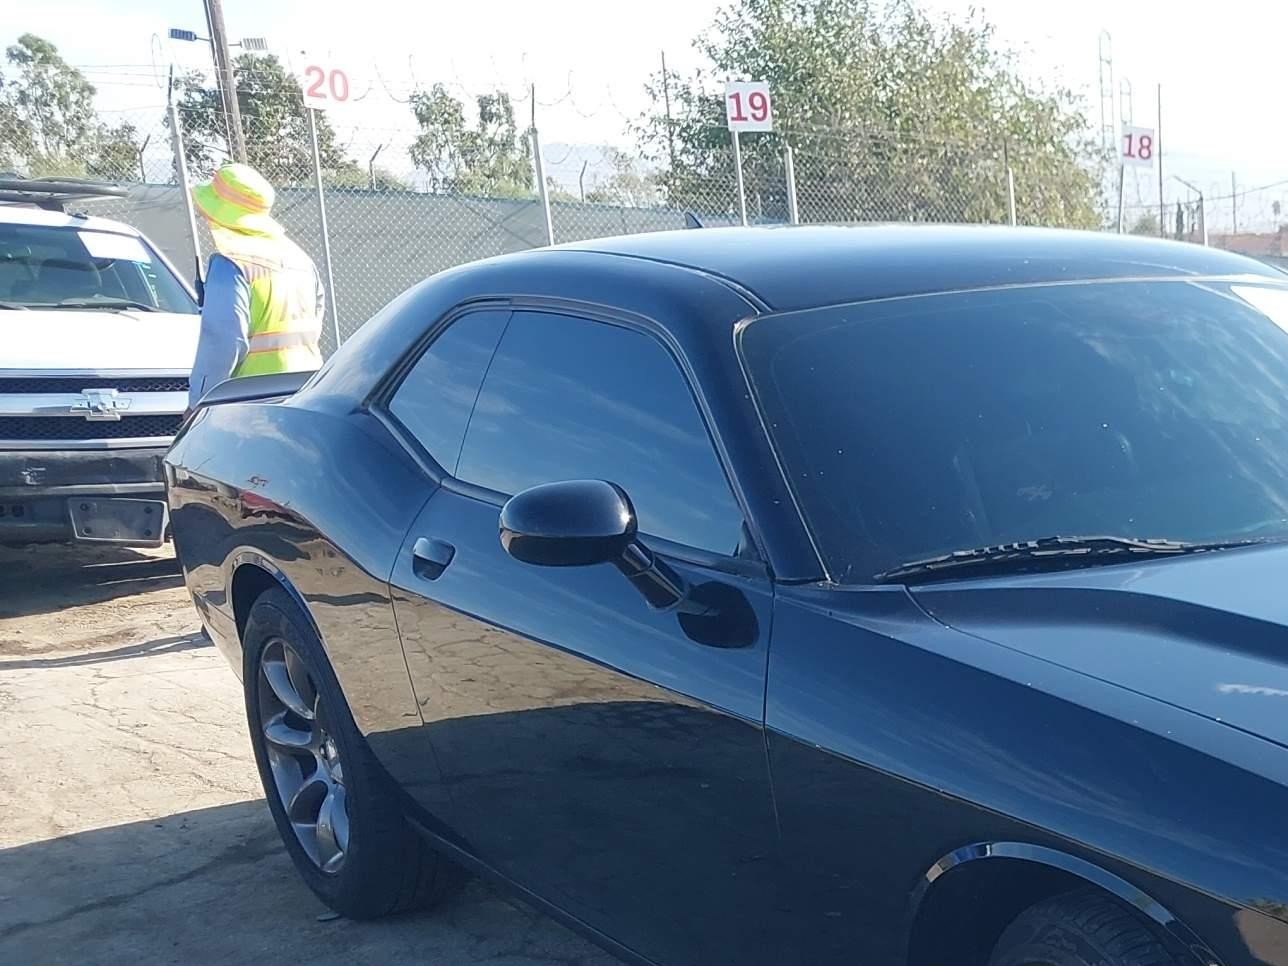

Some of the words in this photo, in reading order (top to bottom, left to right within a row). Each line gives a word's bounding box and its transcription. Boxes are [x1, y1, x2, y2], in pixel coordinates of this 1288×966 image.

[304, 65, 349, 103] 20
[728, 89, 769, 123] 19
[1122, 132, 1153, 160] 18
